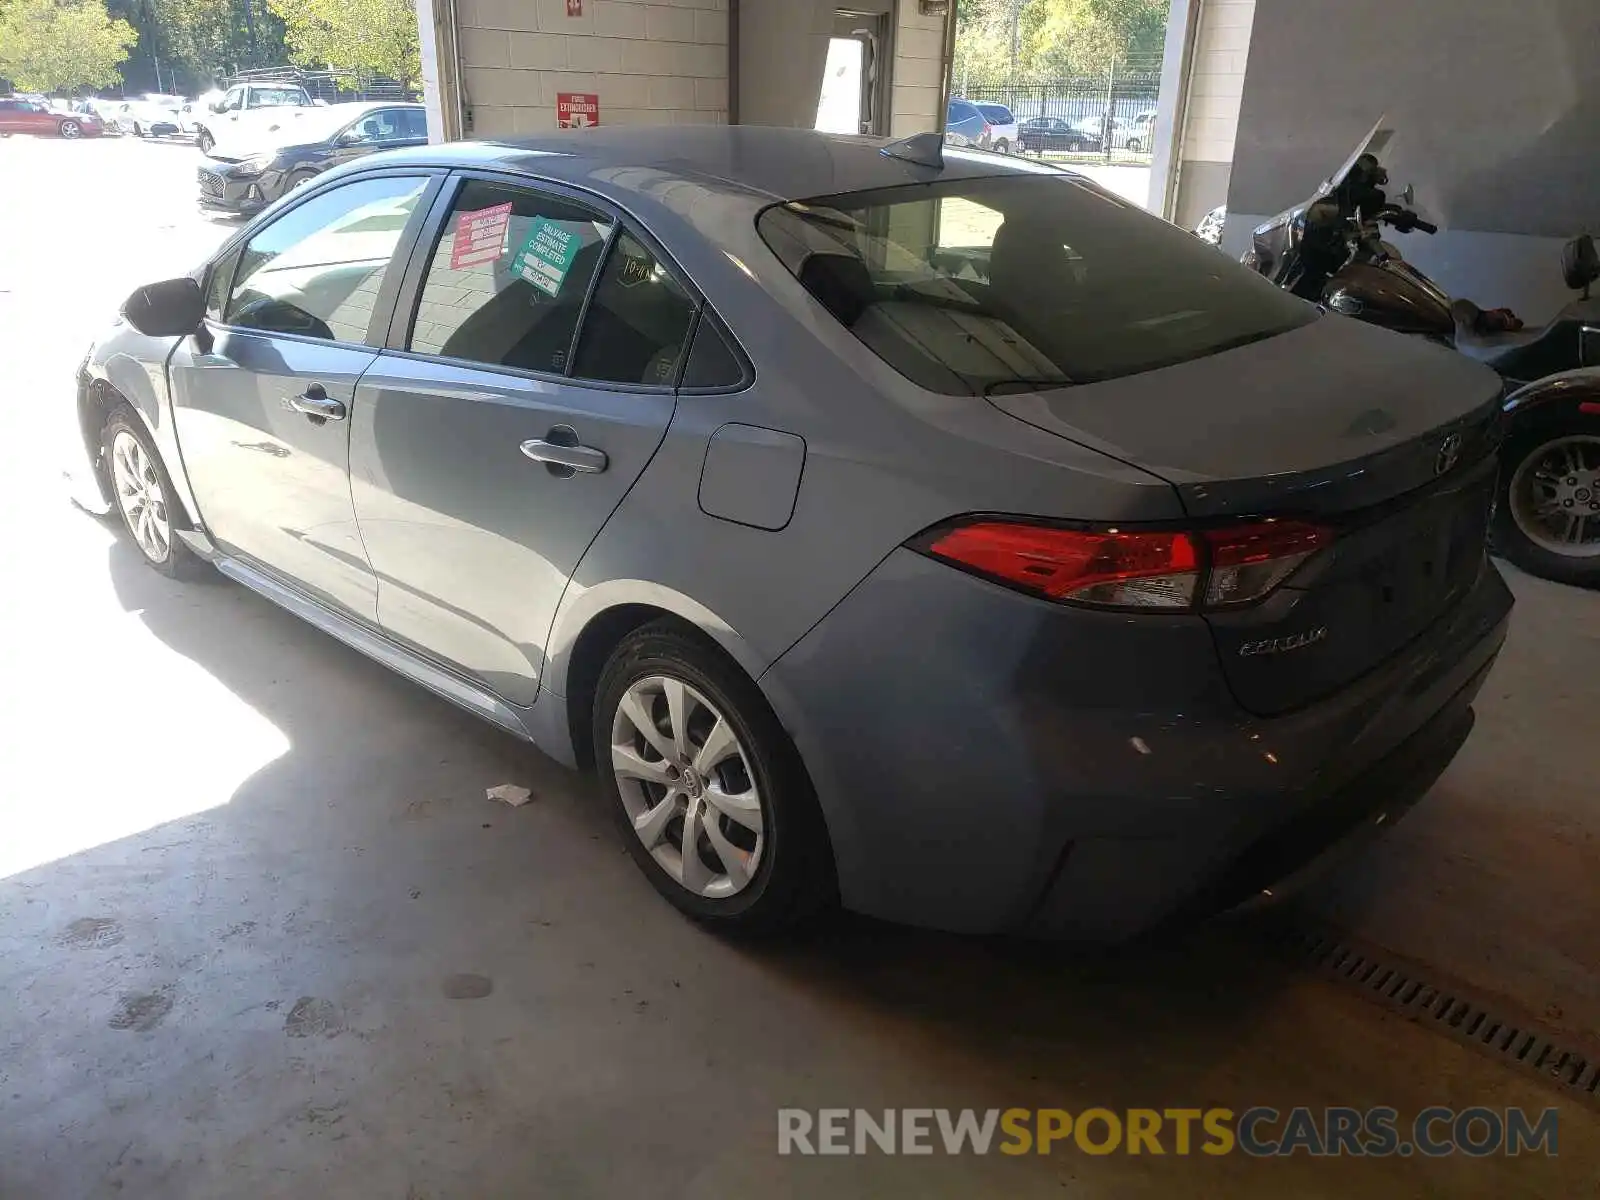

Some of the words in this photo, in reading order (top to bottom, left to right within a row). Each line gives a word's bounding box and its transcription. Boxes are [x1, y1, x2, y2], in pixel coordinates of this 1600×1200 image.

[560, 103, 597, 113] EXTINGUISHER
[536, 231, 568, 254] ESTIMATE
[543, 223, 572, 244] SALVAGE
[528, 239, 566, 265] COMPLETED
